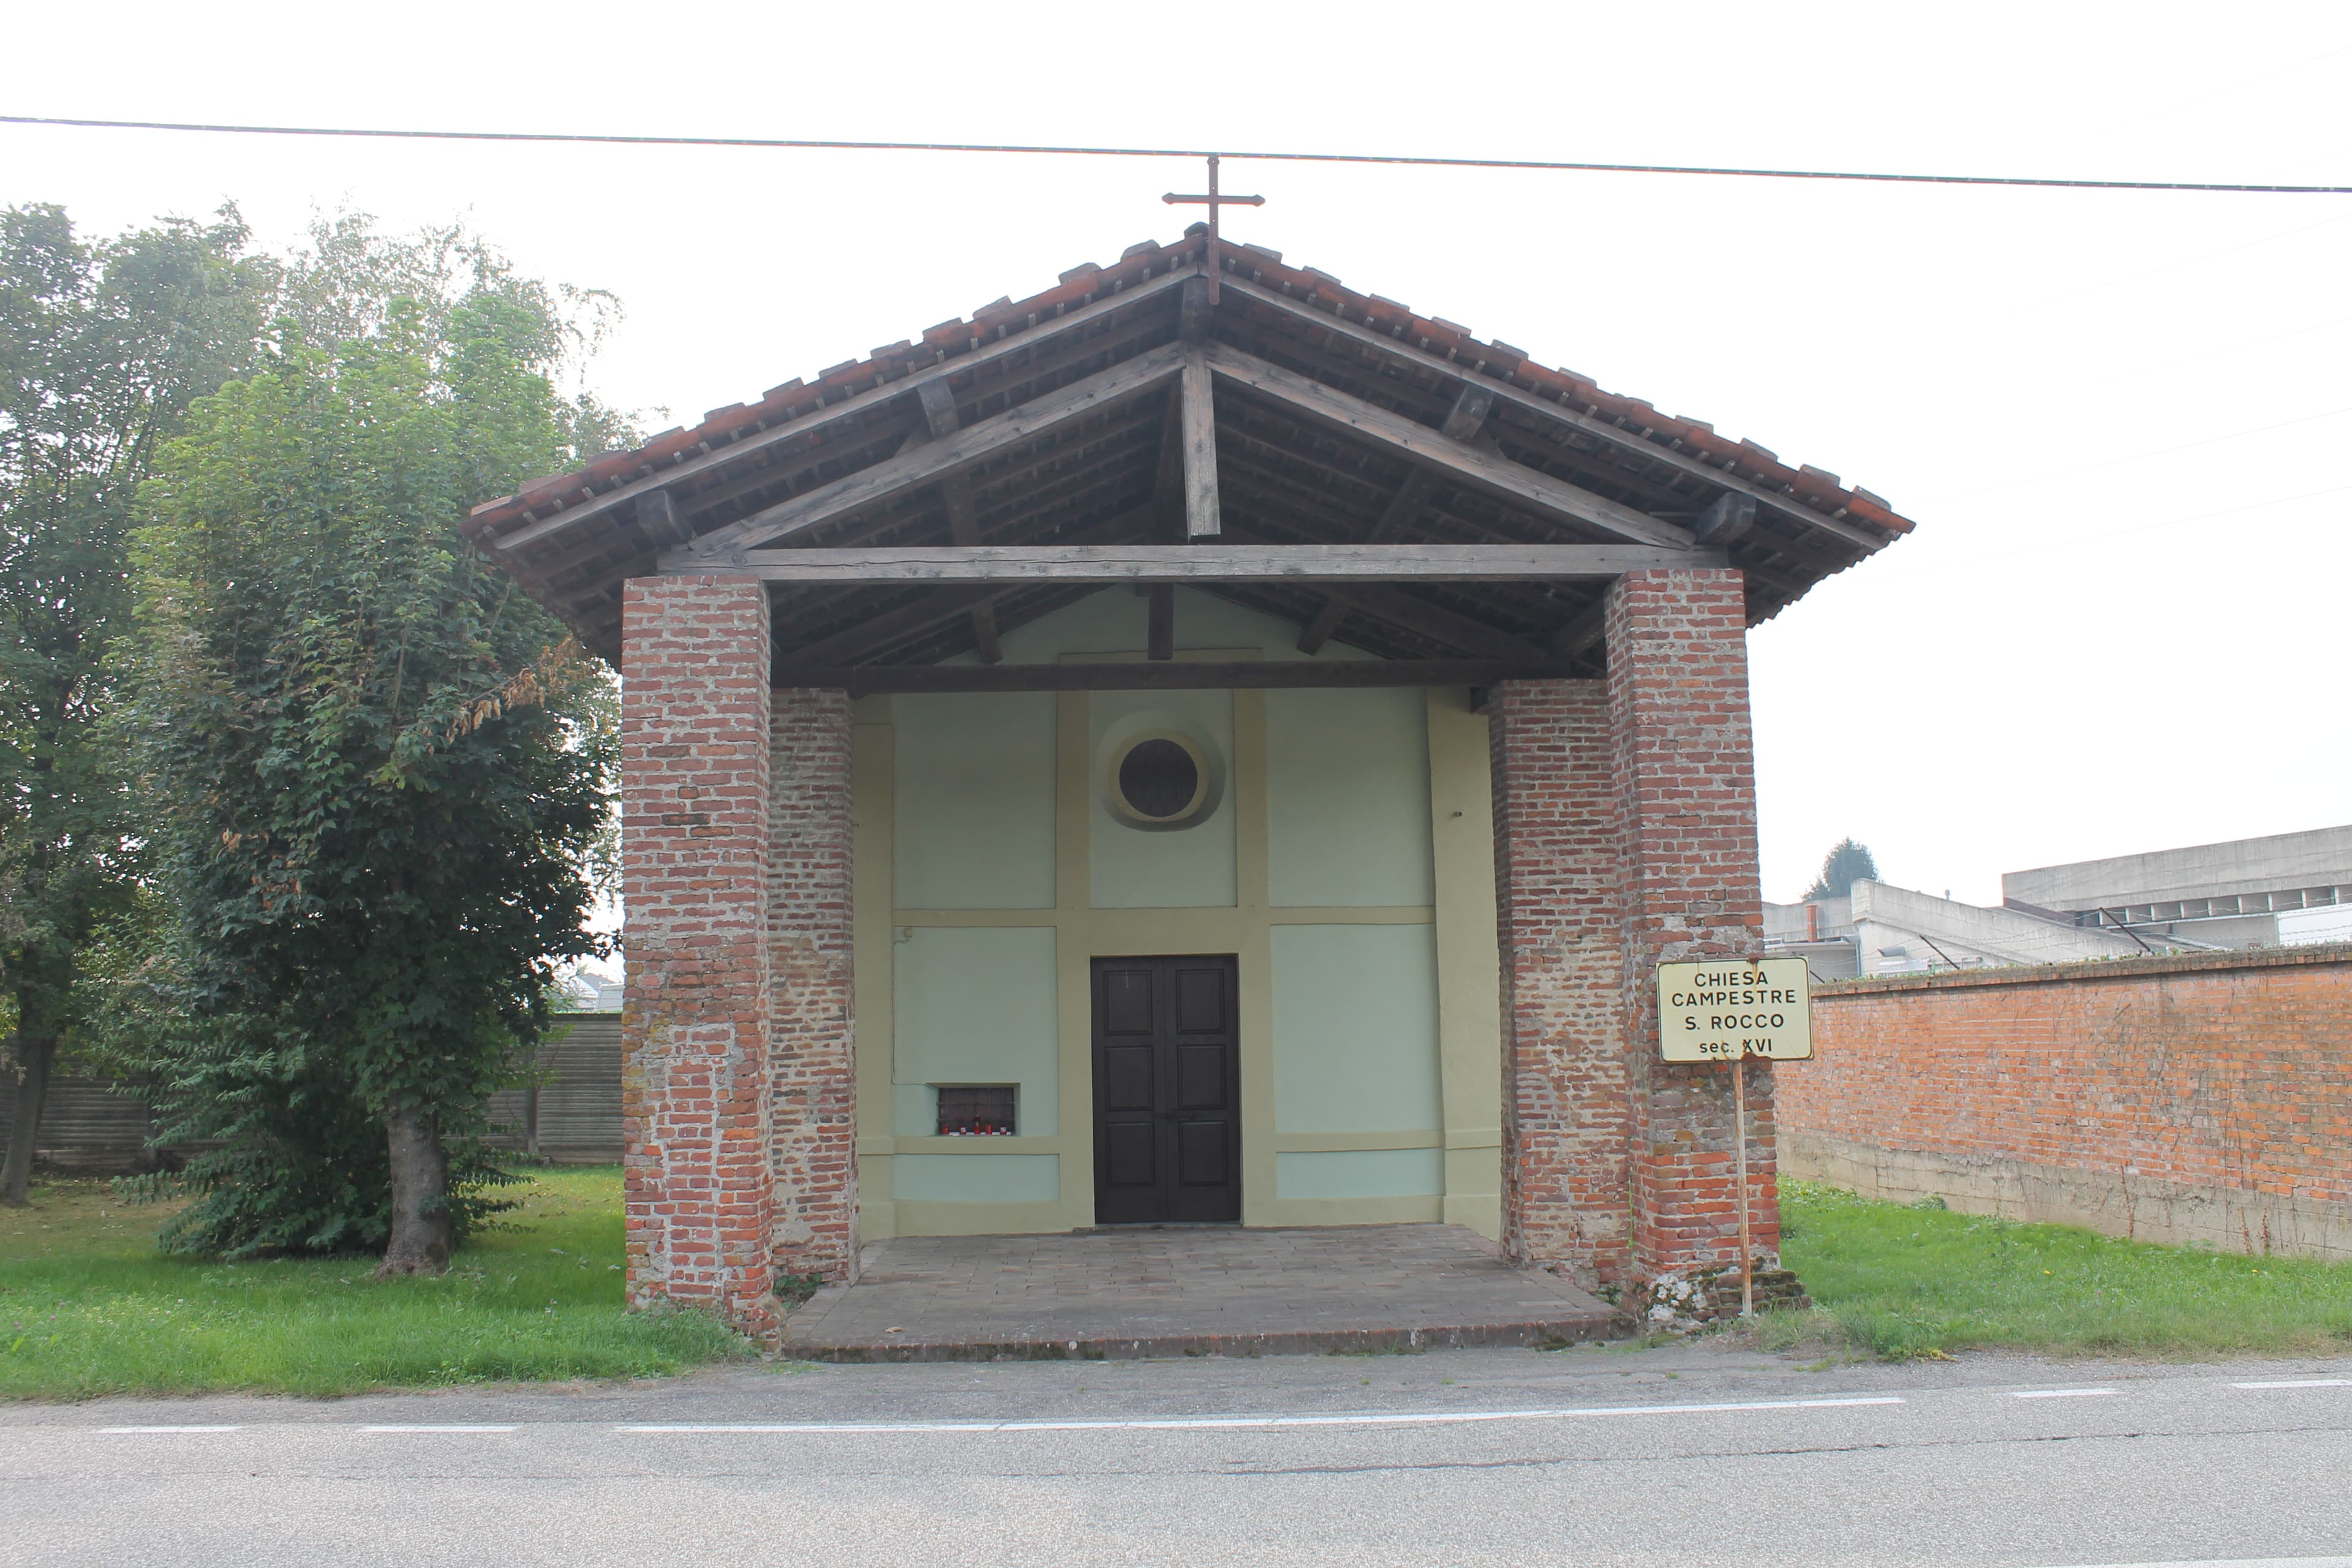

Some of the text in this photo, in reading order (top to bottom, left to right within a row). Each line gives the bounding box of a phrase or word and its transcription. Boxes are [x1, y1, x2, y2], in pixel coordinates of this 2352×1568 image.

[1694, 971, 1768, 987] CHIESA
[1672, 989, 1796, 1006] CAMPESTRE
[1685, 1014, 1784, 1030] S. ROCCO
[1699, 1038, 1772, 1053] sec. XVI
